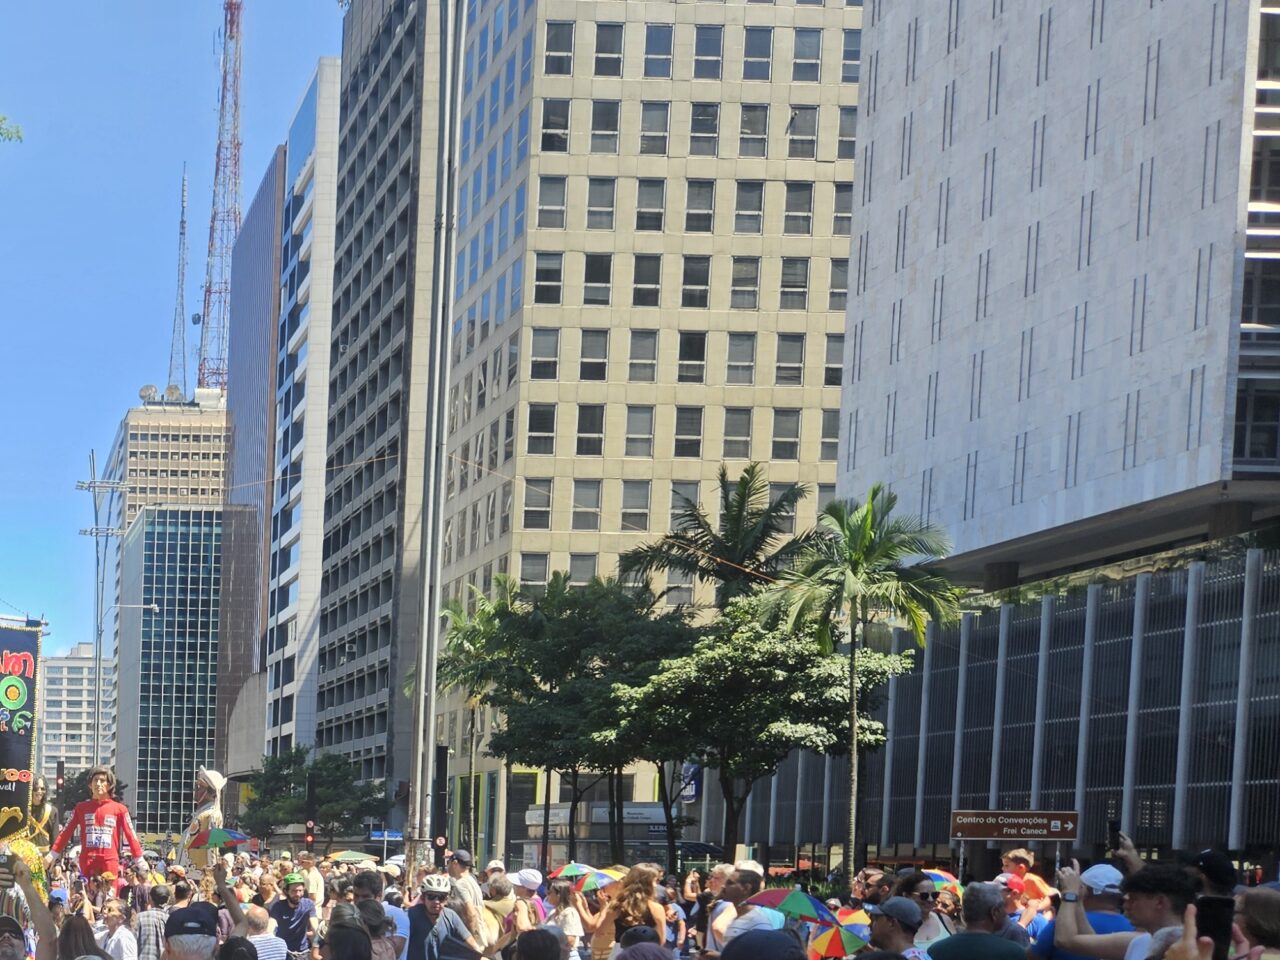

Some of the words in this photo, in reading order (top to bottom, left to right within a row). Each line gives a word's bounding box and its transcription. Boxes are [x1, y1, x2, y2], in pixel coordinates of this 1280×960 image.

[956, 816, 984, 824] Centro
[986, 816, 996, 824] de
[998, 816, 1048, 826] Convenções
[1003, 827, 1017, 835] Frei
[1020, 827, 1048, 835] Caneca
